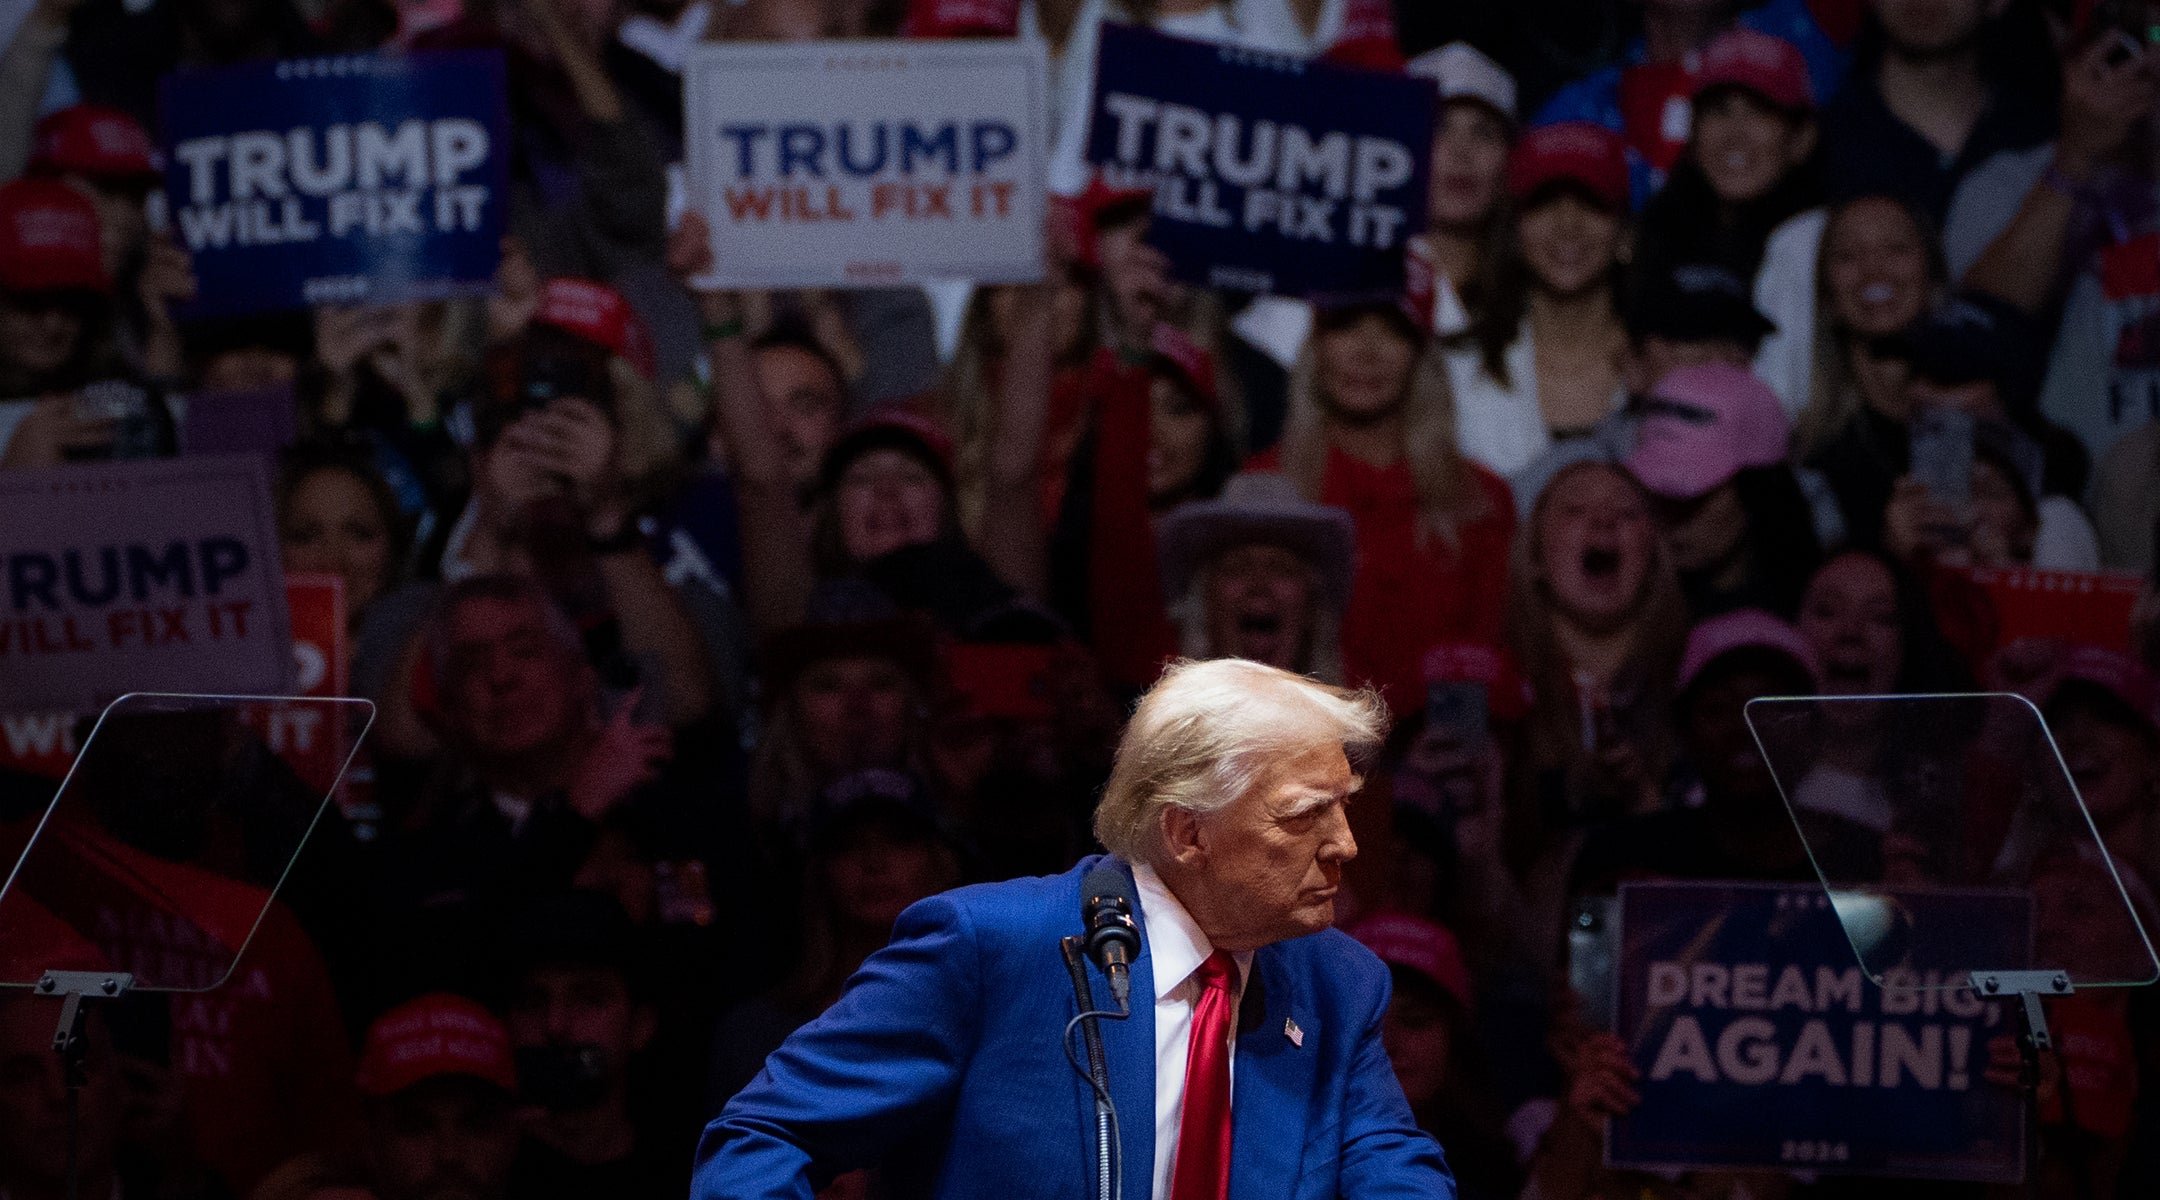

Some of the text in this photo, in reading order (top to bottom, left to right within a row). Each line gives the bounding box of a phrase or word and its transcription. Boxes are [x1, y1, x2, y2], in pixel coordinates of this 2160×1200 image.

[176, 118, 489, 203] TRUMP
[723, 121, 1016, 175] TRUMP
[1104, 91, 1414, 203] TRUMP
[179, 185, 489, 250] WILL FIX IT
[726, 183, 1014, 220] WILL FIX IT
[1245, 189, 1336, 242] FIX
[1348, 205, 1406, 248] IT
[0, 539, 247, 608] RUMP
[109, 609, 187, 646] FIX
[211, 603, 250, 638] IT
[270, 708, 321, 754] IT
[1648, 962, 1999, 1026] DREAM BIG,
[1649, 1015, 1972, 1089] AGAIN!
